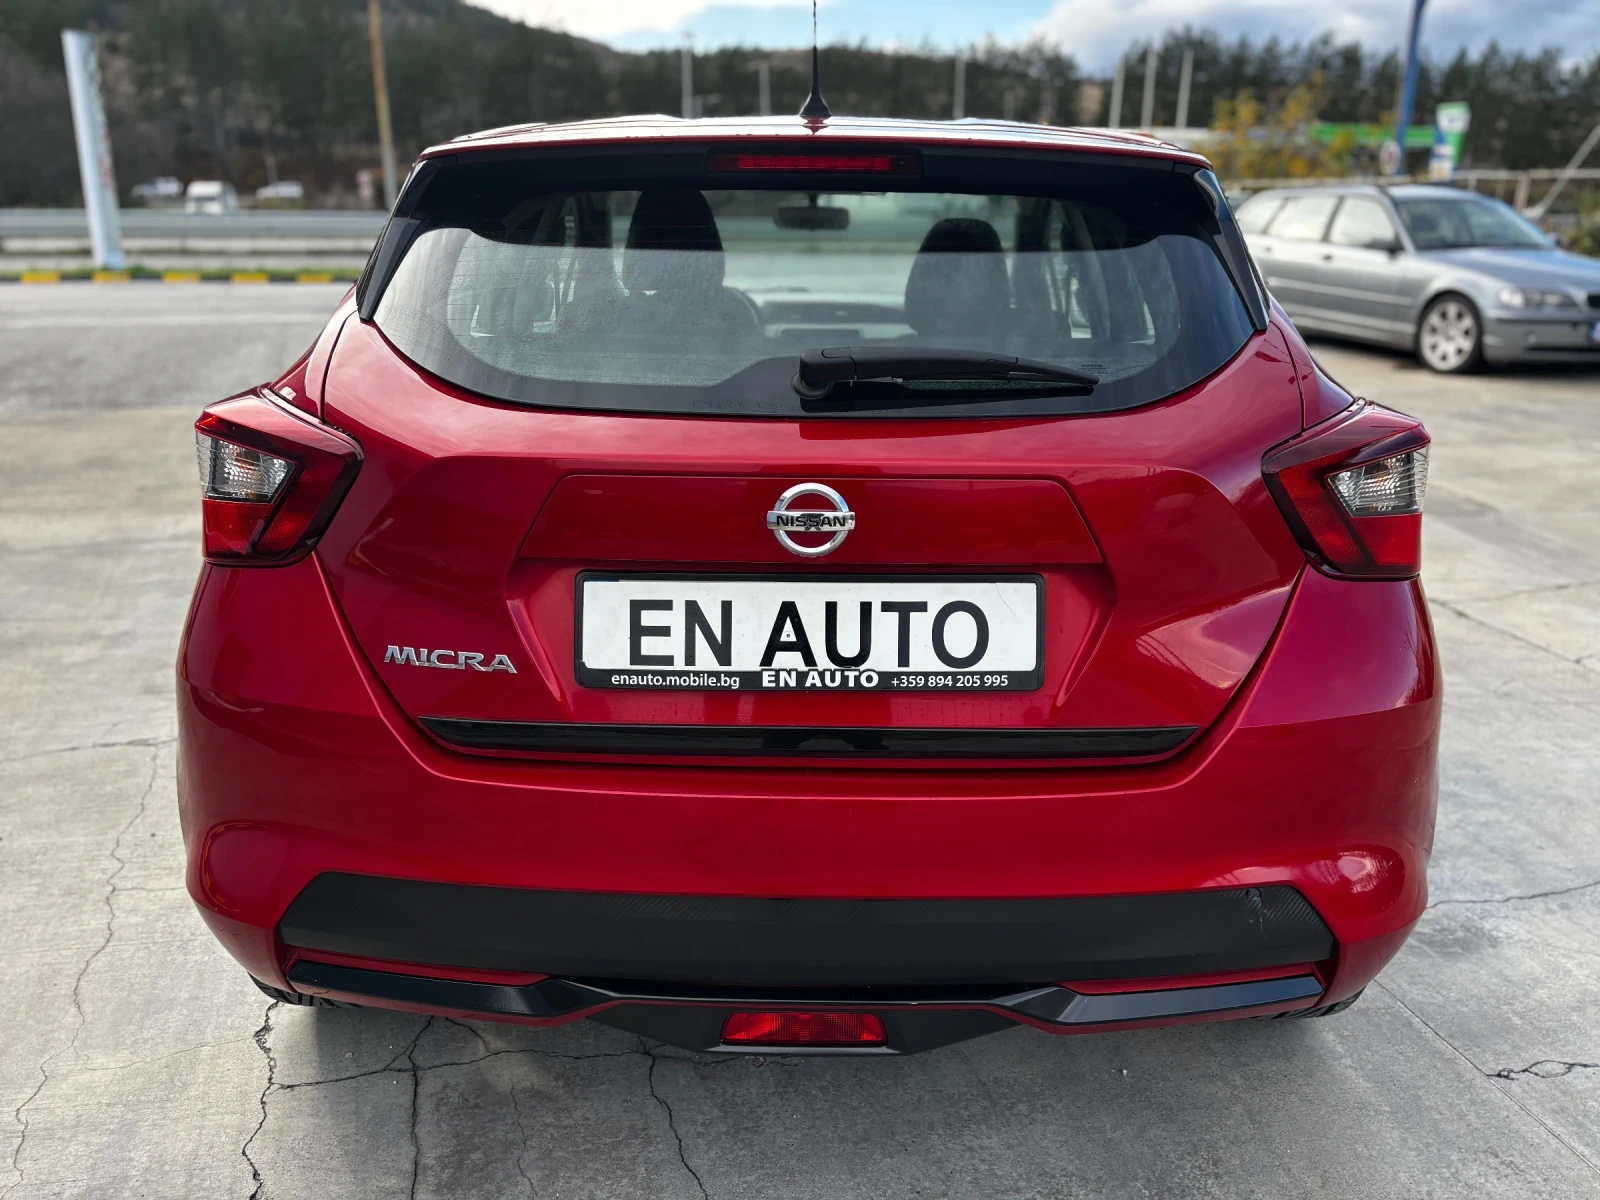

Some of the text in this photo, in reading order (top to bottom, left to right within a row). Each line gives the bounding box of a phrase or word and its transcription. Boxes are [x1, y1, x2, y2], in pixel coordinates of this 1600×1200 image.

[776, 515, 846, 527] NISSAN
[629, 599, 990, 669] EN AUTO
[384, 645, 518, 674] MICRA
[611, 673, 740, 690] enauto.mobile.bg
[762, 670, 879, 688] EN AUTO
[891, 675, 1009, 687] +359 894 205 995
